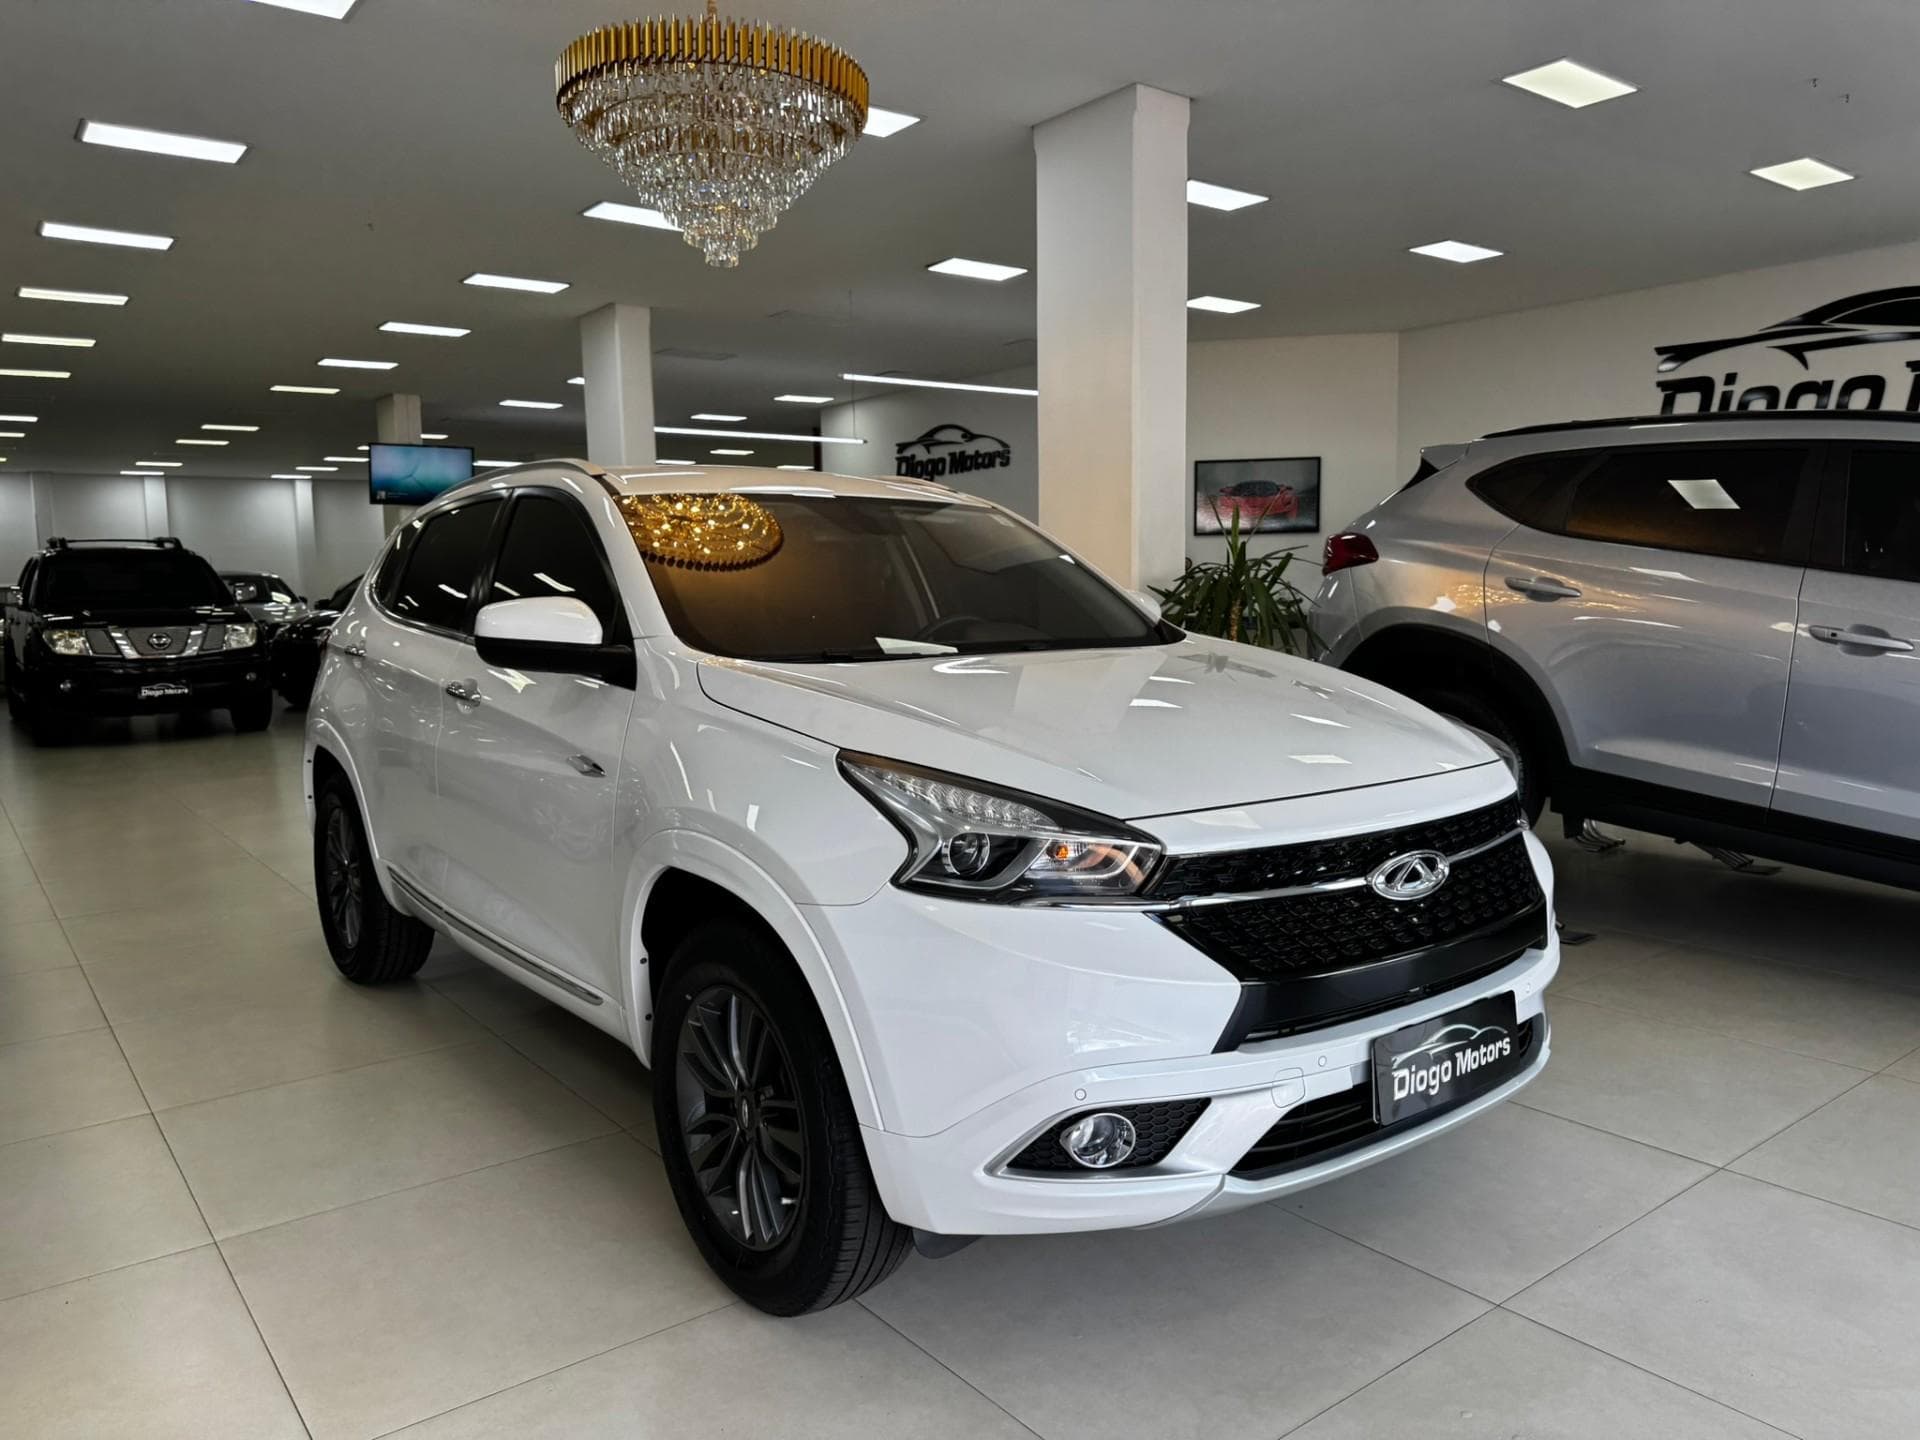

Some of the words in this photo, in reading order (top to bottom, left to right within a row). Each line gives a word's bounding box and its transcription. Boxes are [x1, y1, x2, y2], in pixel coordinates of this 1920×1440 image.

[895, 454, 946, 481] Diogo
[948, 449, 1010, 475] Motors
[1392, 1060, 1452, 1101] Diogo
[1455, 1037, 1510, 1077] Motors
